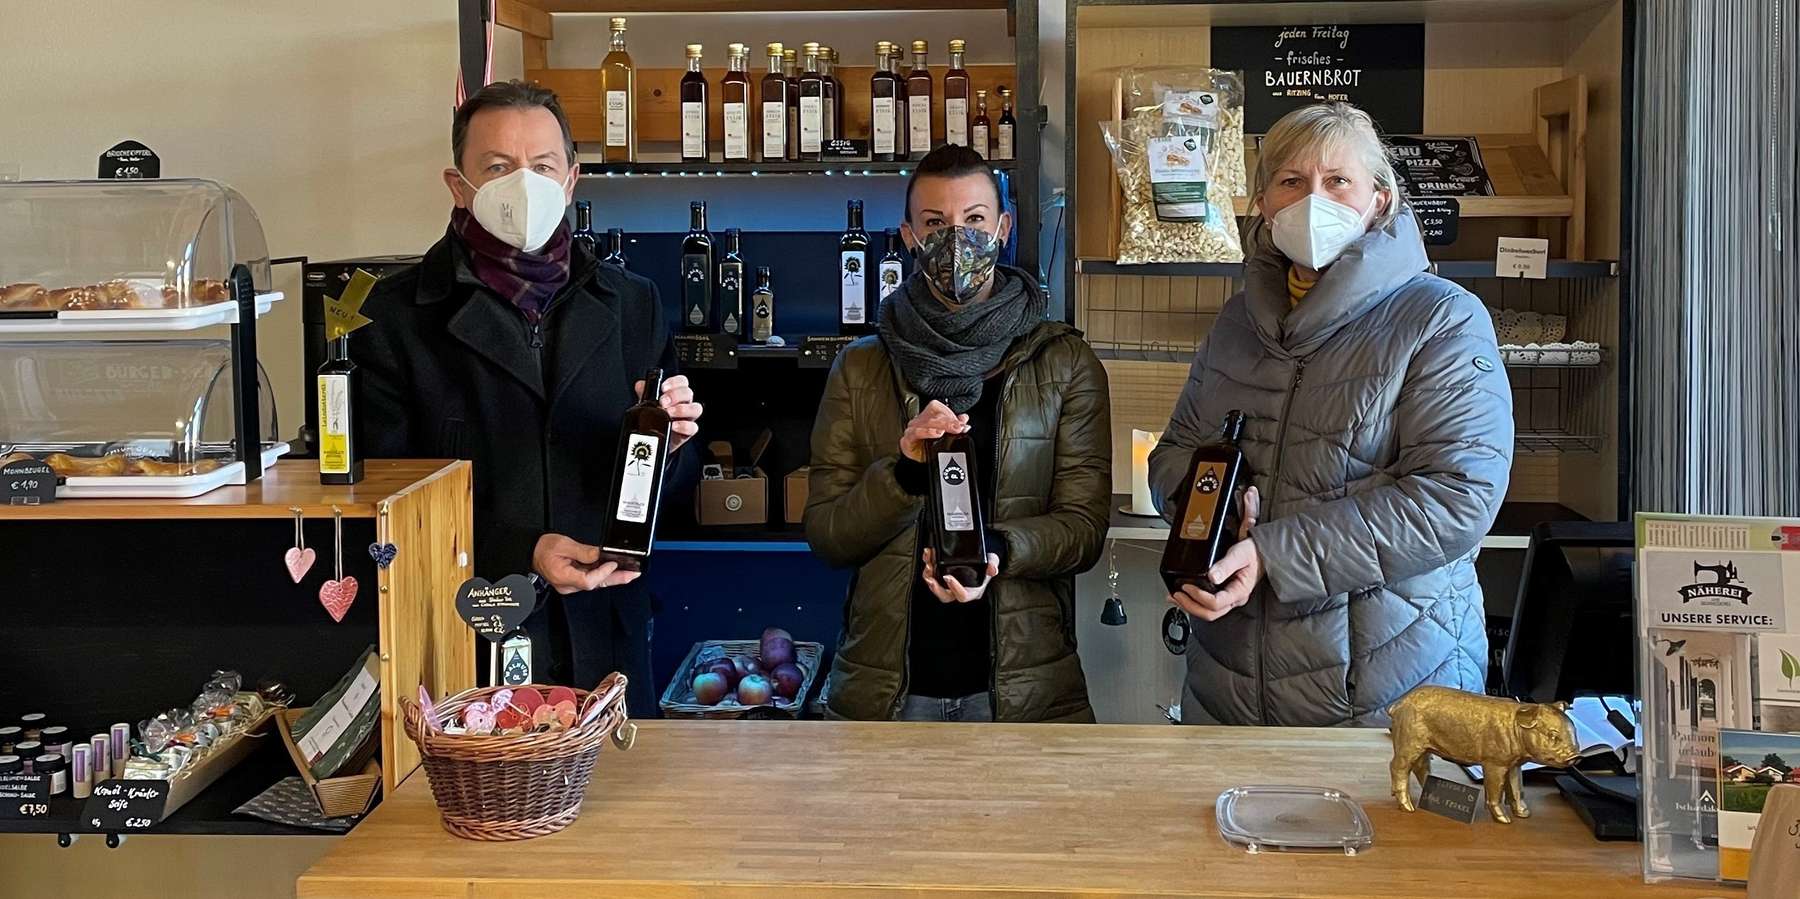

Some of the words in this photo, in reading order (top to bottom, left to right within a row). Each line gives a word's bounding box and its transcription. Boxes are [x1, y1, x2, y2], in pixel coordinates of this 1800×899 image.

[1274, 27, 1306, 48] jeden
[1311, 26, 1351, 49] Freitag
[1286, 51, 1331, 66] frisches
[1265, 70, 1362, 87] BAUERNBROT
[1406, 159, 1443, 167] PIZZA
[1418, 182, 1465, 191] DRINKS
[467, 586, 512, 599] ANHÄNGER
[1687, 585, 1743, 599] NÄHEREI
[1661, 612, 1712, 624] UNSERE
[1716, 613, 1773, 625] SERVICE:
[503, 662, 529, 679] WALNUSS
